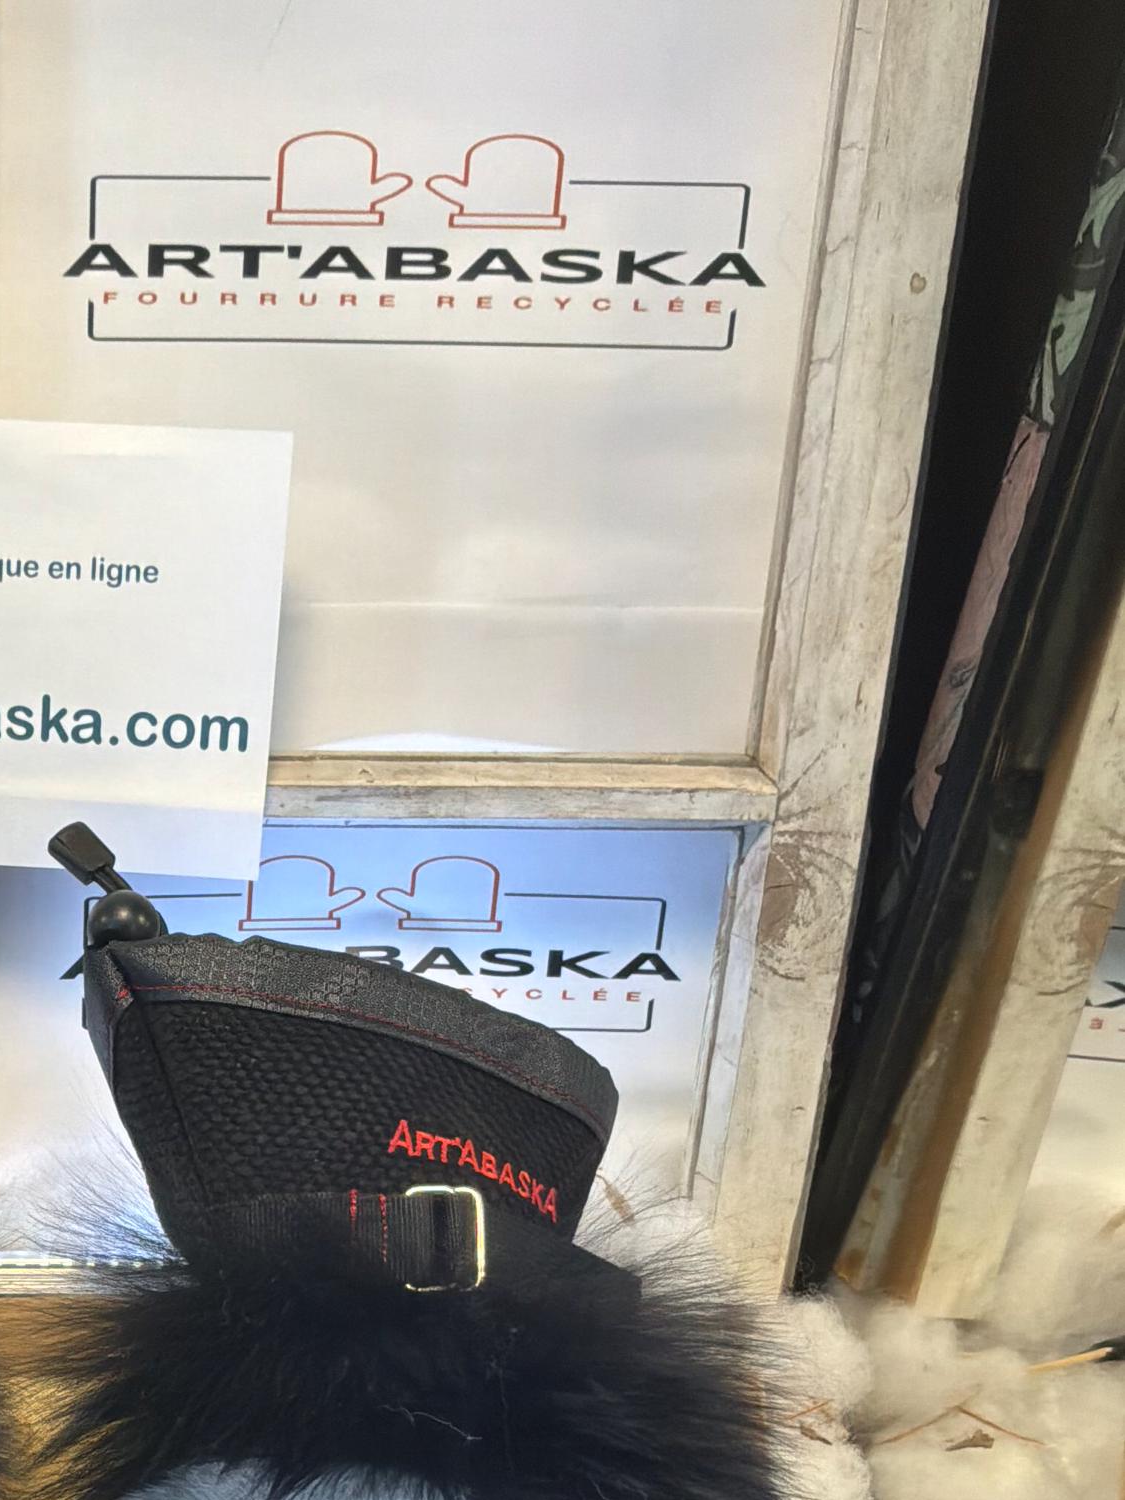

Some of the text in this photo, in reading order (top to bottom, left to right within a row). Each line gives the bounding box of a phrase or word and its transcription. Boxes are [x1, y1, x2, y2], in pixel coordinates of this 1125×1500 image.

[62, 243, 767, 288] ART'ABASKA
[102, 290, 723, 314] FOURRURE RECYCLÉE
[47, 560, 82, 581] en
[90, 556, 159, 588] ligne
